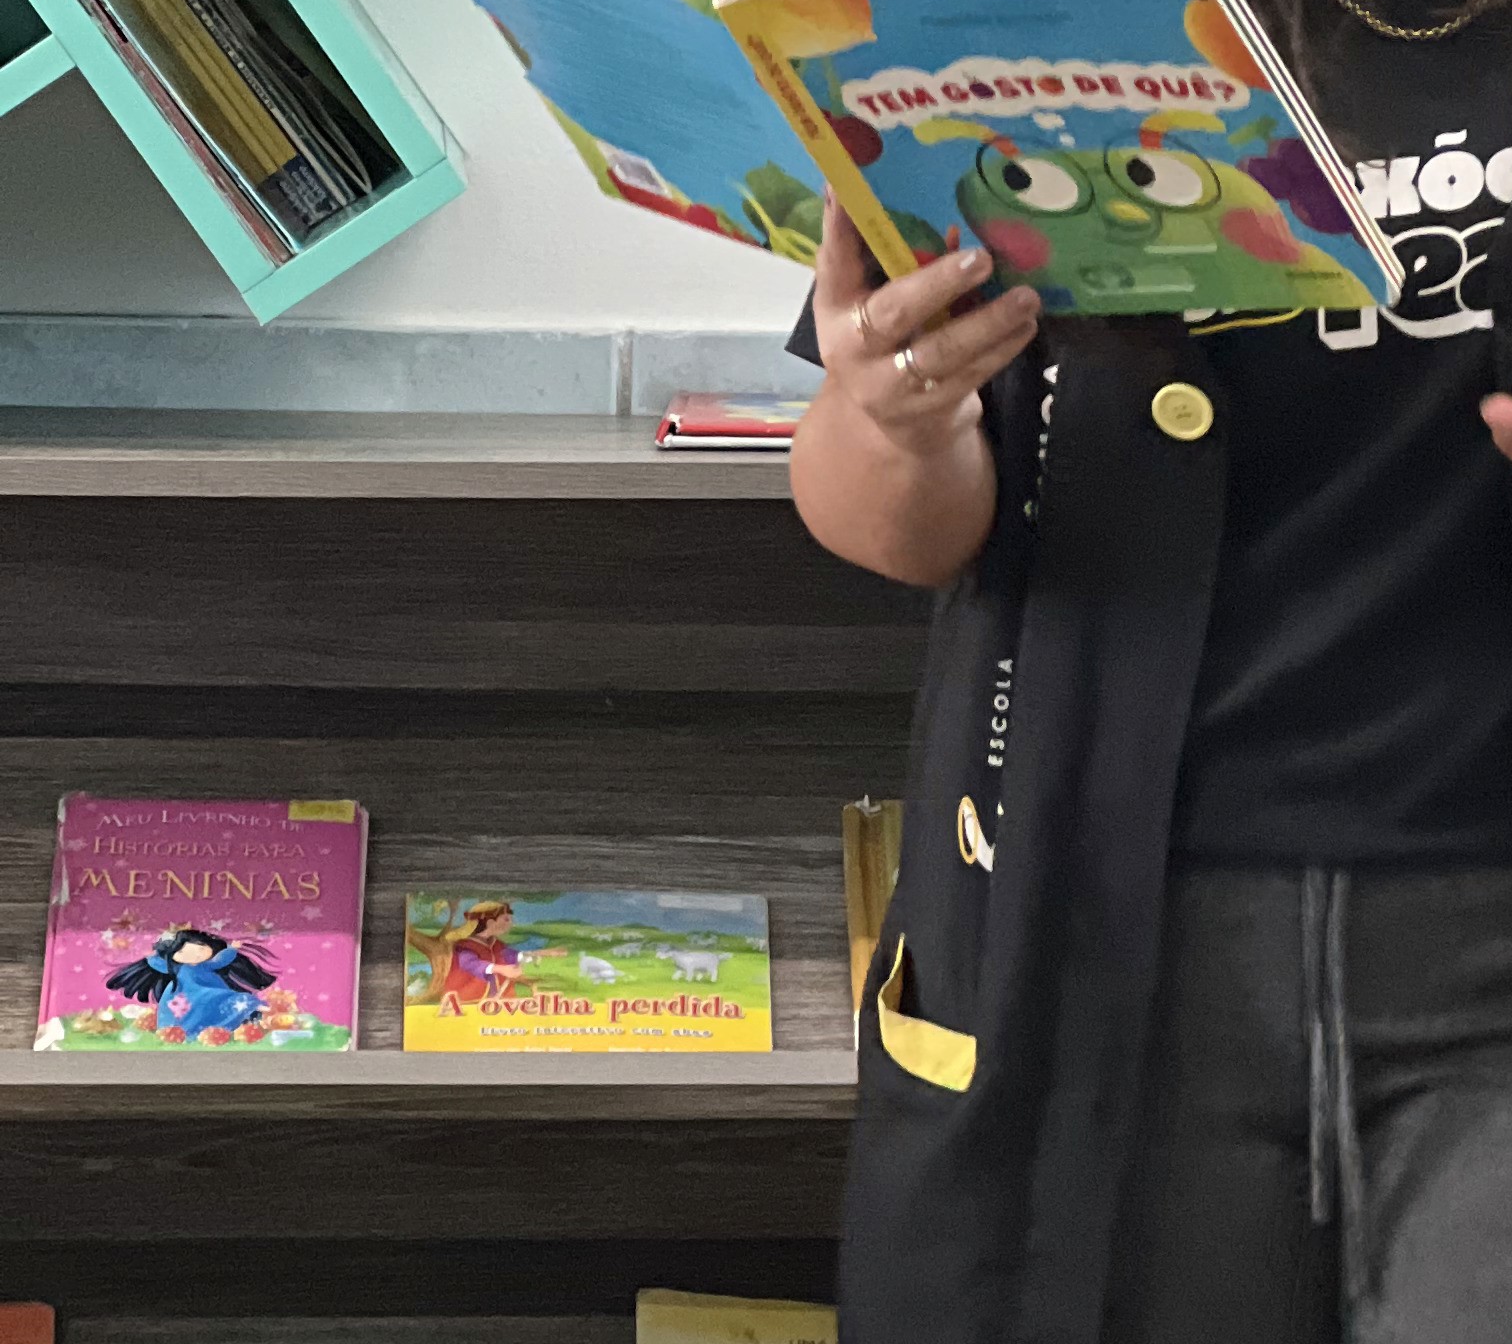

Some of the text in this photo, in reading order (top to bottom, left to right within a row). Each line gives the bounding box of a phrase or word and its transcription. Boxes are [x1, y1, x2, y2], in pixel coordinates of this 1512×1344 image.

[857, 86, 938, 117] TEM
[1072, 73, 1126, 97] DE
[988, 658, 1014, 767] ESCOLA
[76, 867, 321, 901] MENINAS
[437, 991, 746, 1023] A ovelha perdida
